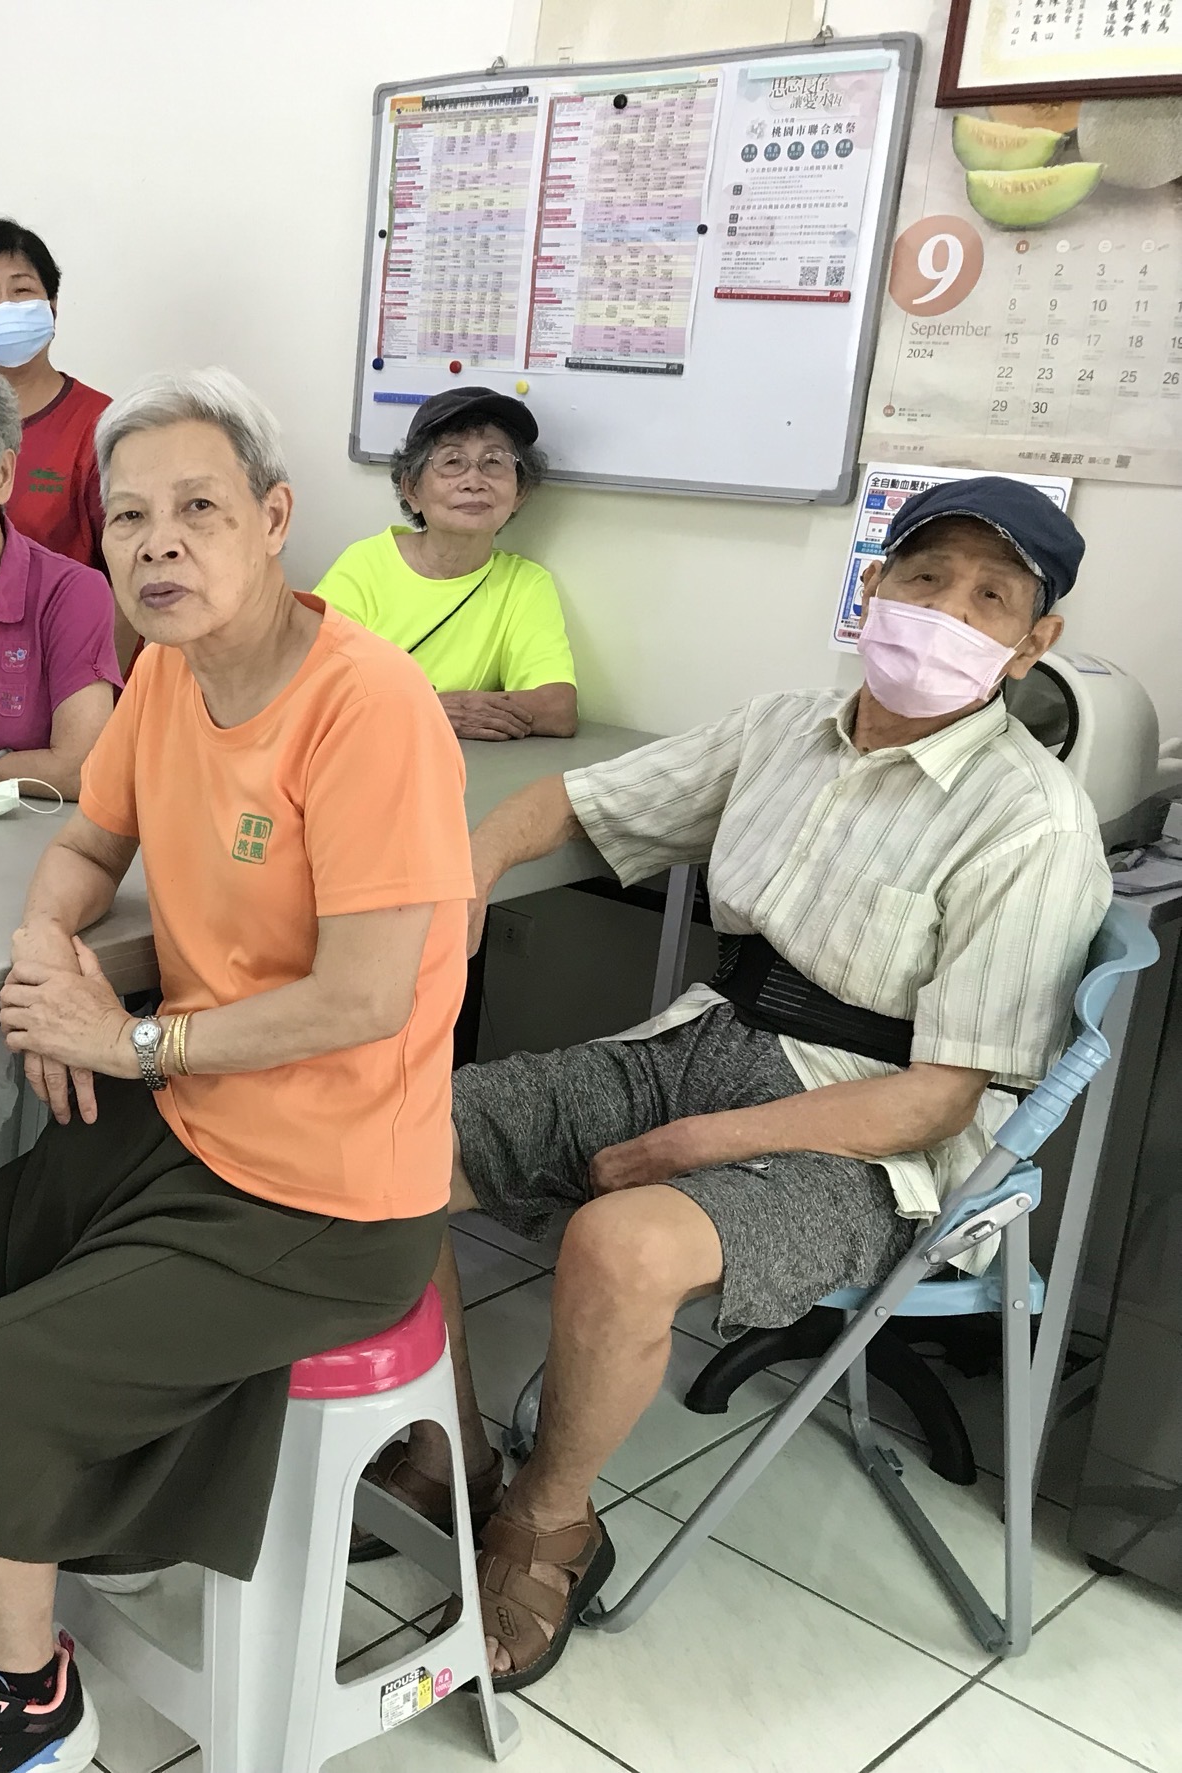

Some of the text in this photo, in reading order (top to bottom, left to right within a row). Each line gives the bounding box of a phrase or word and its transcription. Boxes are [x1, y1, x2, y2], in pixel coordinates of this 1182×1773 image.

[912, 233, 964, 305] 9
[1017, 263, 1148, 277] 1 2 3 4
[1008, 298, 1017, 311] 8
[1049, 298, 1058, 311] 9
[1092, 299, 1107, 312] 10
[1135, 299, 1149, 313] 11
[910, 321, 991, 339] September
[1004, 333, 1019, 345] 15
[1045, 333, 1060, 346] 16
[1086, 334, 1102, 347] 17
[1128, 335, 1144, 348] 18
[906, 348, 934, 359] 2024
[996, 366, 1180, 385] 22 23 24 25 26
[991, 399, 1048, 414] 29 30
[1049, 452, 1084, 465] 張善政
[240, 818, 268, 839] 運動
[237, 838, 264, 860] 桃園
[385, 1669, 421, 1695] HOUSE
